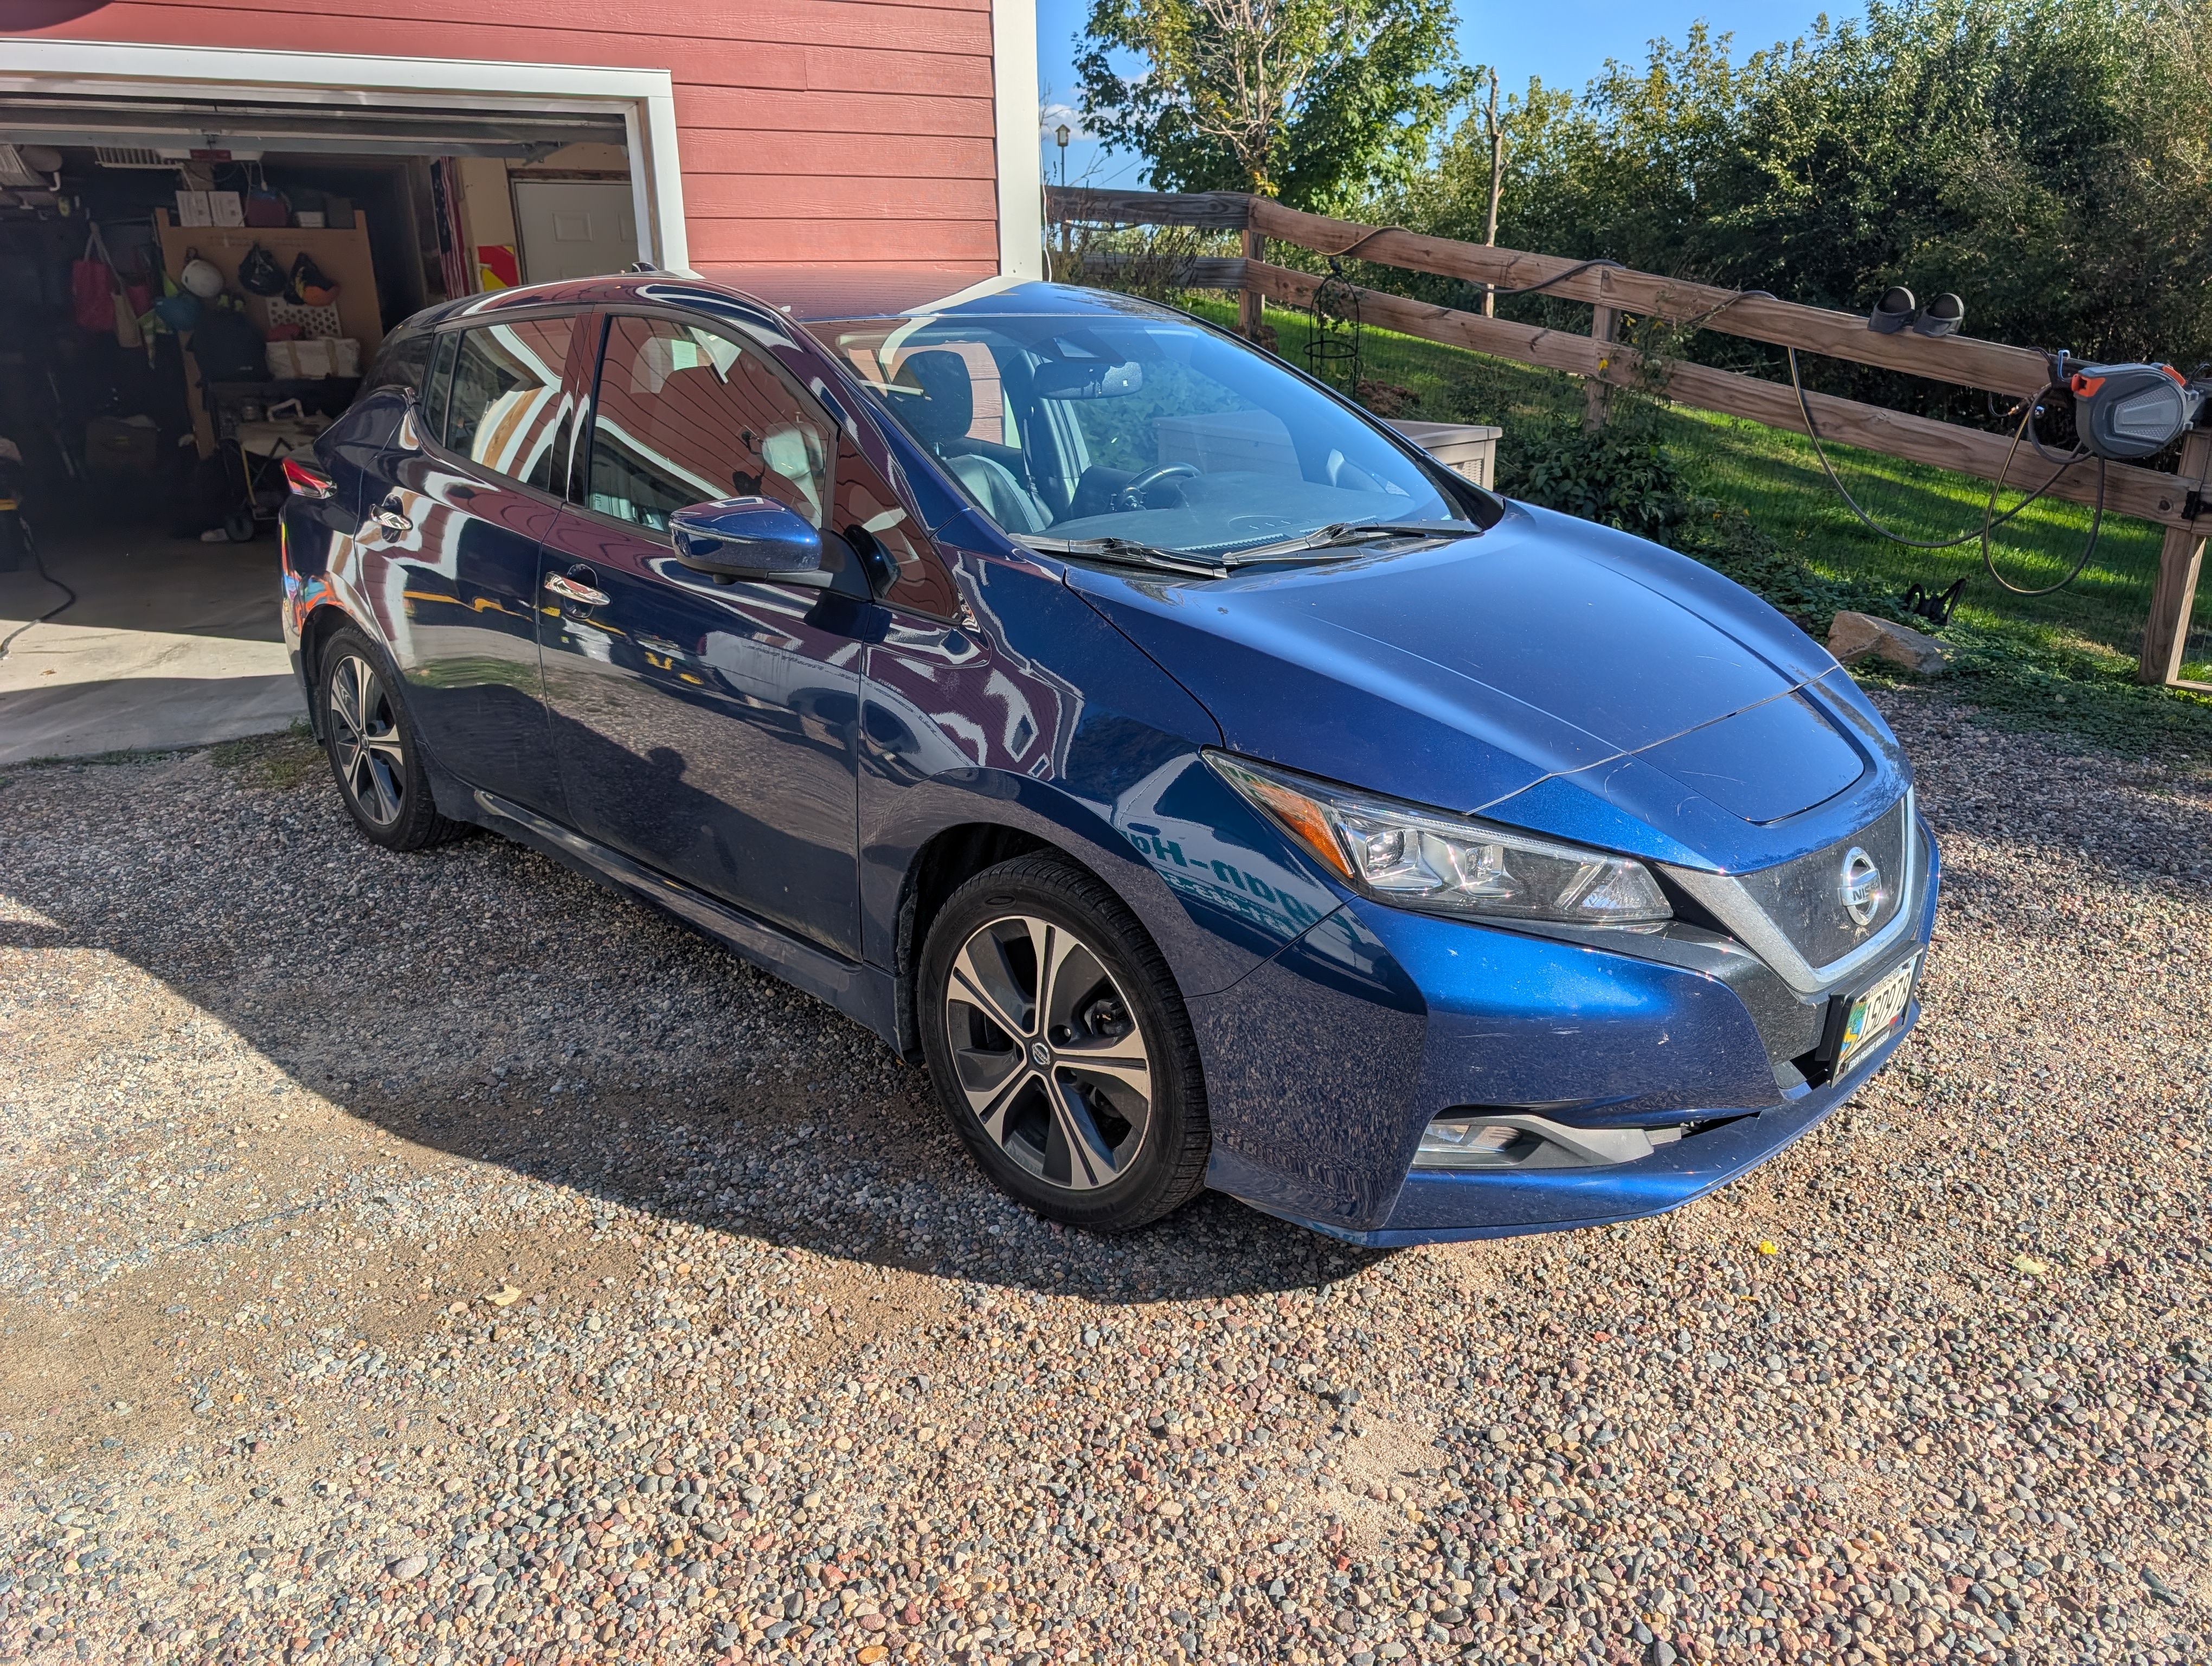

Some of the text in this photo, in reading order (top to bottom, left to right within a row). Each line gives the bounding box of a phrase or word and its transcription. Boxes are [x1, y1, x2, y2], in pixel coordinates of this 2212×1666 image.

[1853, 971, 1911, 1044] 1SD978
[1875, 1029, 1891, 1048] NISSAN
[1033, 1046, 1048, 1063] NISSAN
